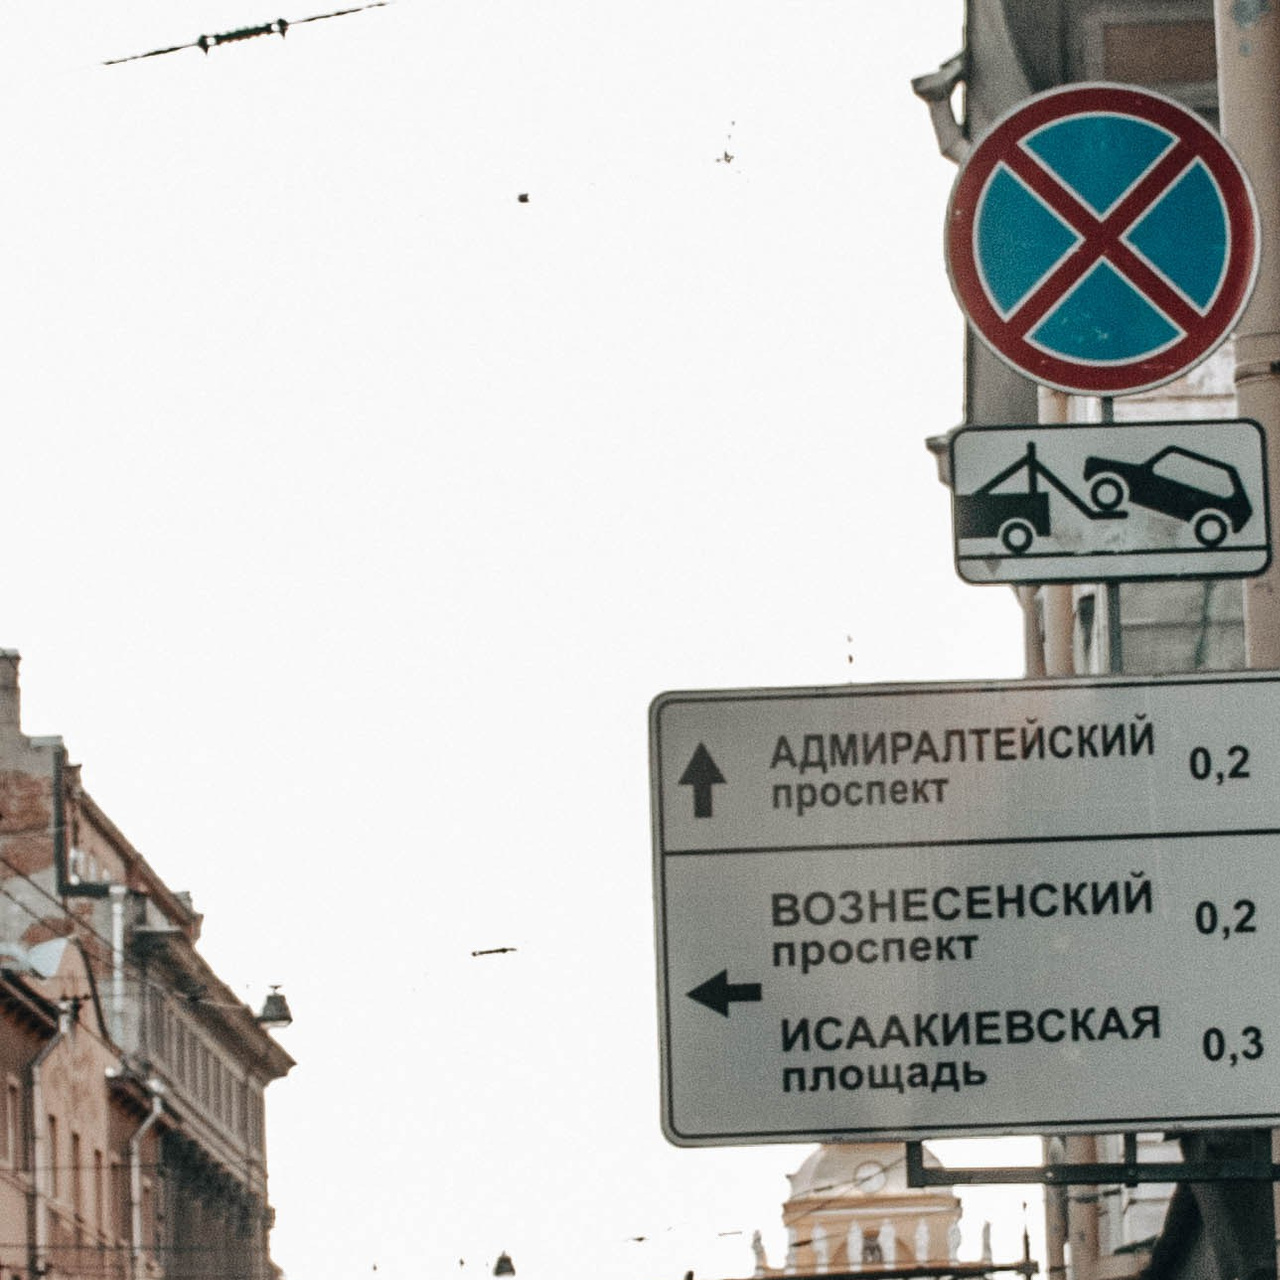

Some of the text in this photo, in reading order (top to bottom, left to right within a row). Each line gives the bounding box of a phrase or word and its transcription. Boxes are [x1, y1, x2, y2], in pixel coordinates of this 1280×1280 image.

[770, 713, 1251, 786] АДМИРАЛТЕЙСКИЙ 0,2
[772, 777, 950, 816] проспект
[771, 871, 1257, 940] ВОЗНЕСЕНСКИЙ 0,2
[772, 934, 980, 974] проспект
[780, 1005, 1265, 1067] ИСААКИЕВСКАЯ 0,3
[782, 1060, 988, 1095] площадь
